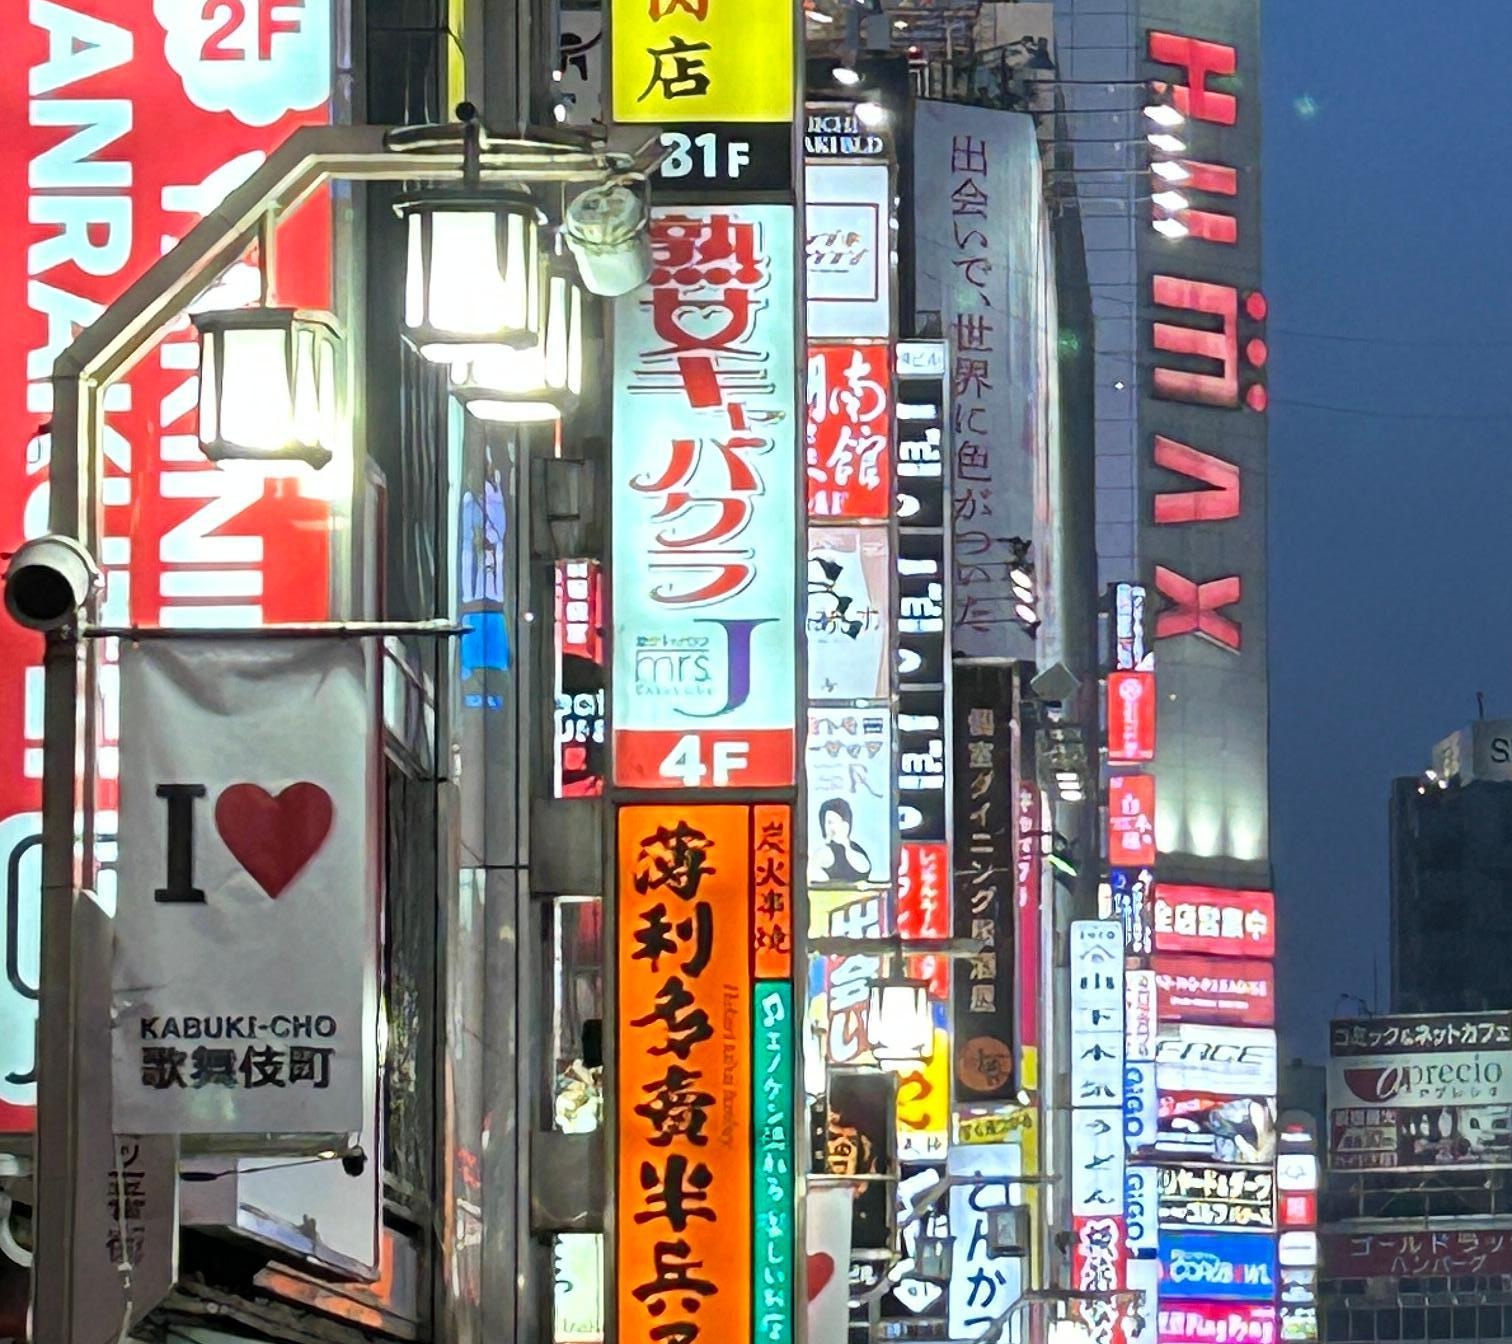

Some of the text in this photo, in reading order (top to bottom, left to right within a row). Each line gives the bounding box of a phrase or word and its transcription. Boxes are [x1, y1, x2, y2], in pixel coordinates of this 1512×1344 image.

[660, 735, 749, 786] 4F
[154, 783, 207, 903] I
[140, 1015, 337, 1040] KABUKI-CHO
[140, 1044, 336, 1091] 歌舞伎町
